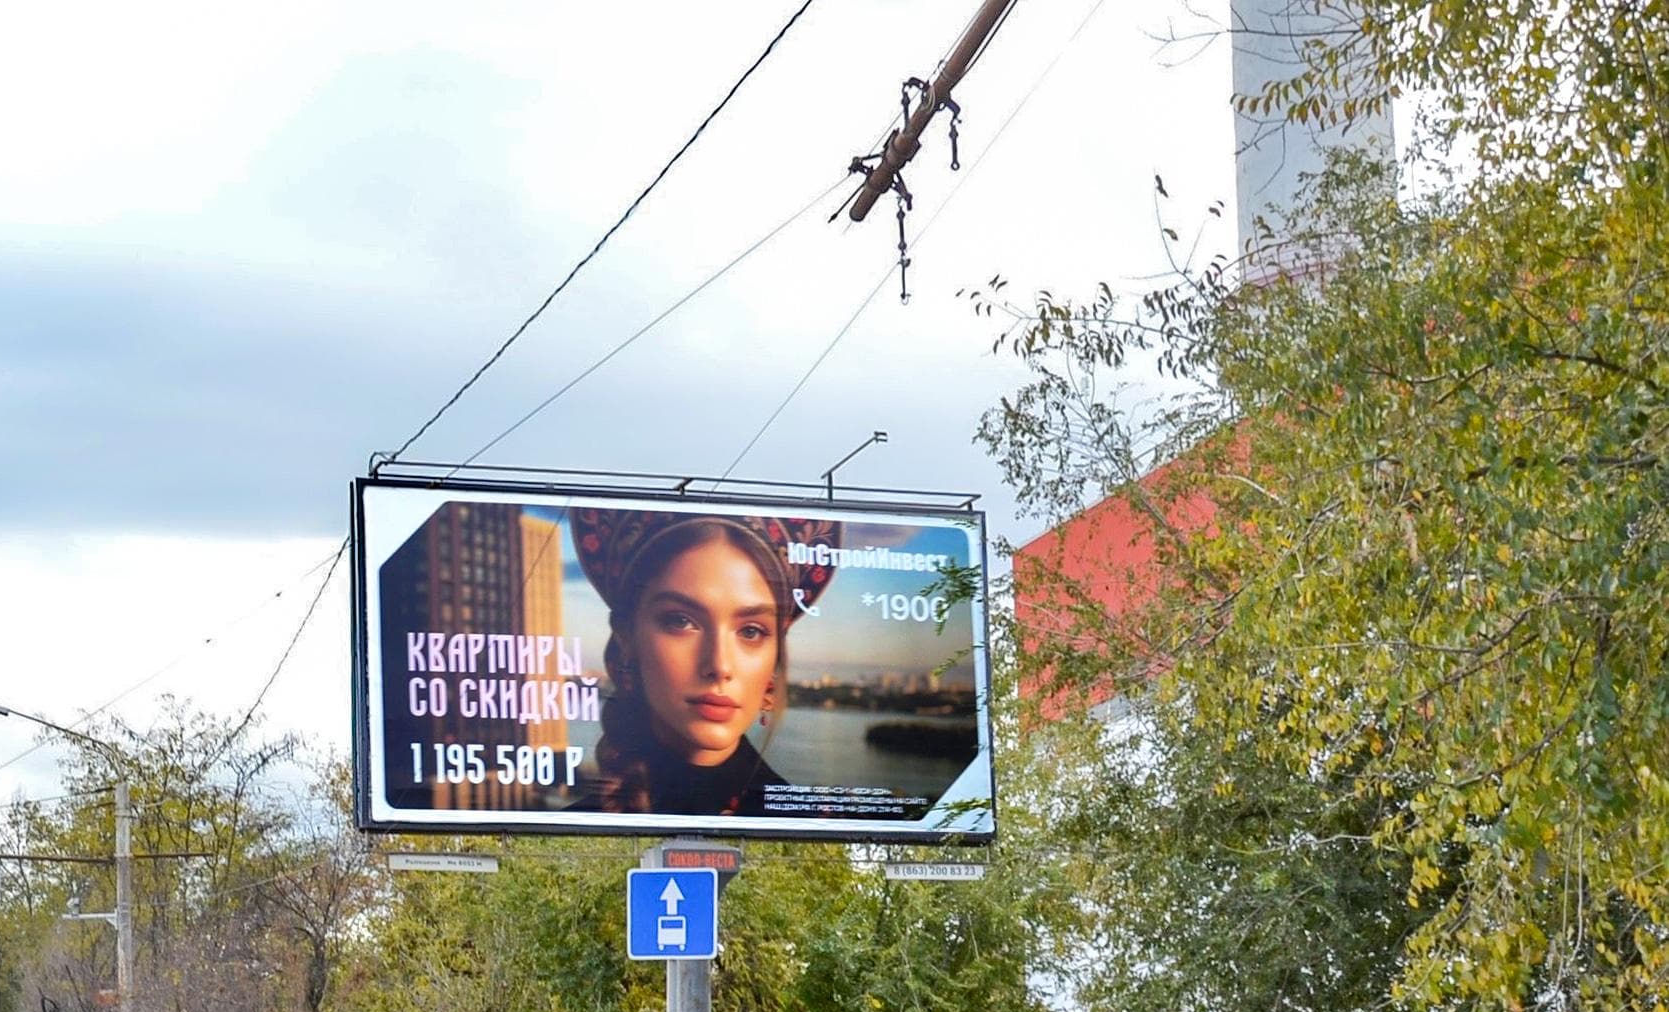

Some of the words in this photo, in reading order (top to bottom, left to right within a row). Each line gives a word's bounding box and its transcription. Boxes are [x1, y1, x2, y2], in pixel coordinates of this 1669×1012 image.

[788, 542, 948, 572] ЮгСтройИнвест
[407, 632, 582, 676] КВАРТИРЫ
[409, 677, 448, 717] СО
[459, 677, 600, 724] СКИДКОЙ
[410, 743, 422, 783] 1
[434, 743, 485, 784] 195
[496, 745, 555, 785] 500
[902, 866, 927, 876] (863)
[930, 866, 948, 876] 200
[950, 866, 962, 875] 83
[965, 866, 976, 875] 23
